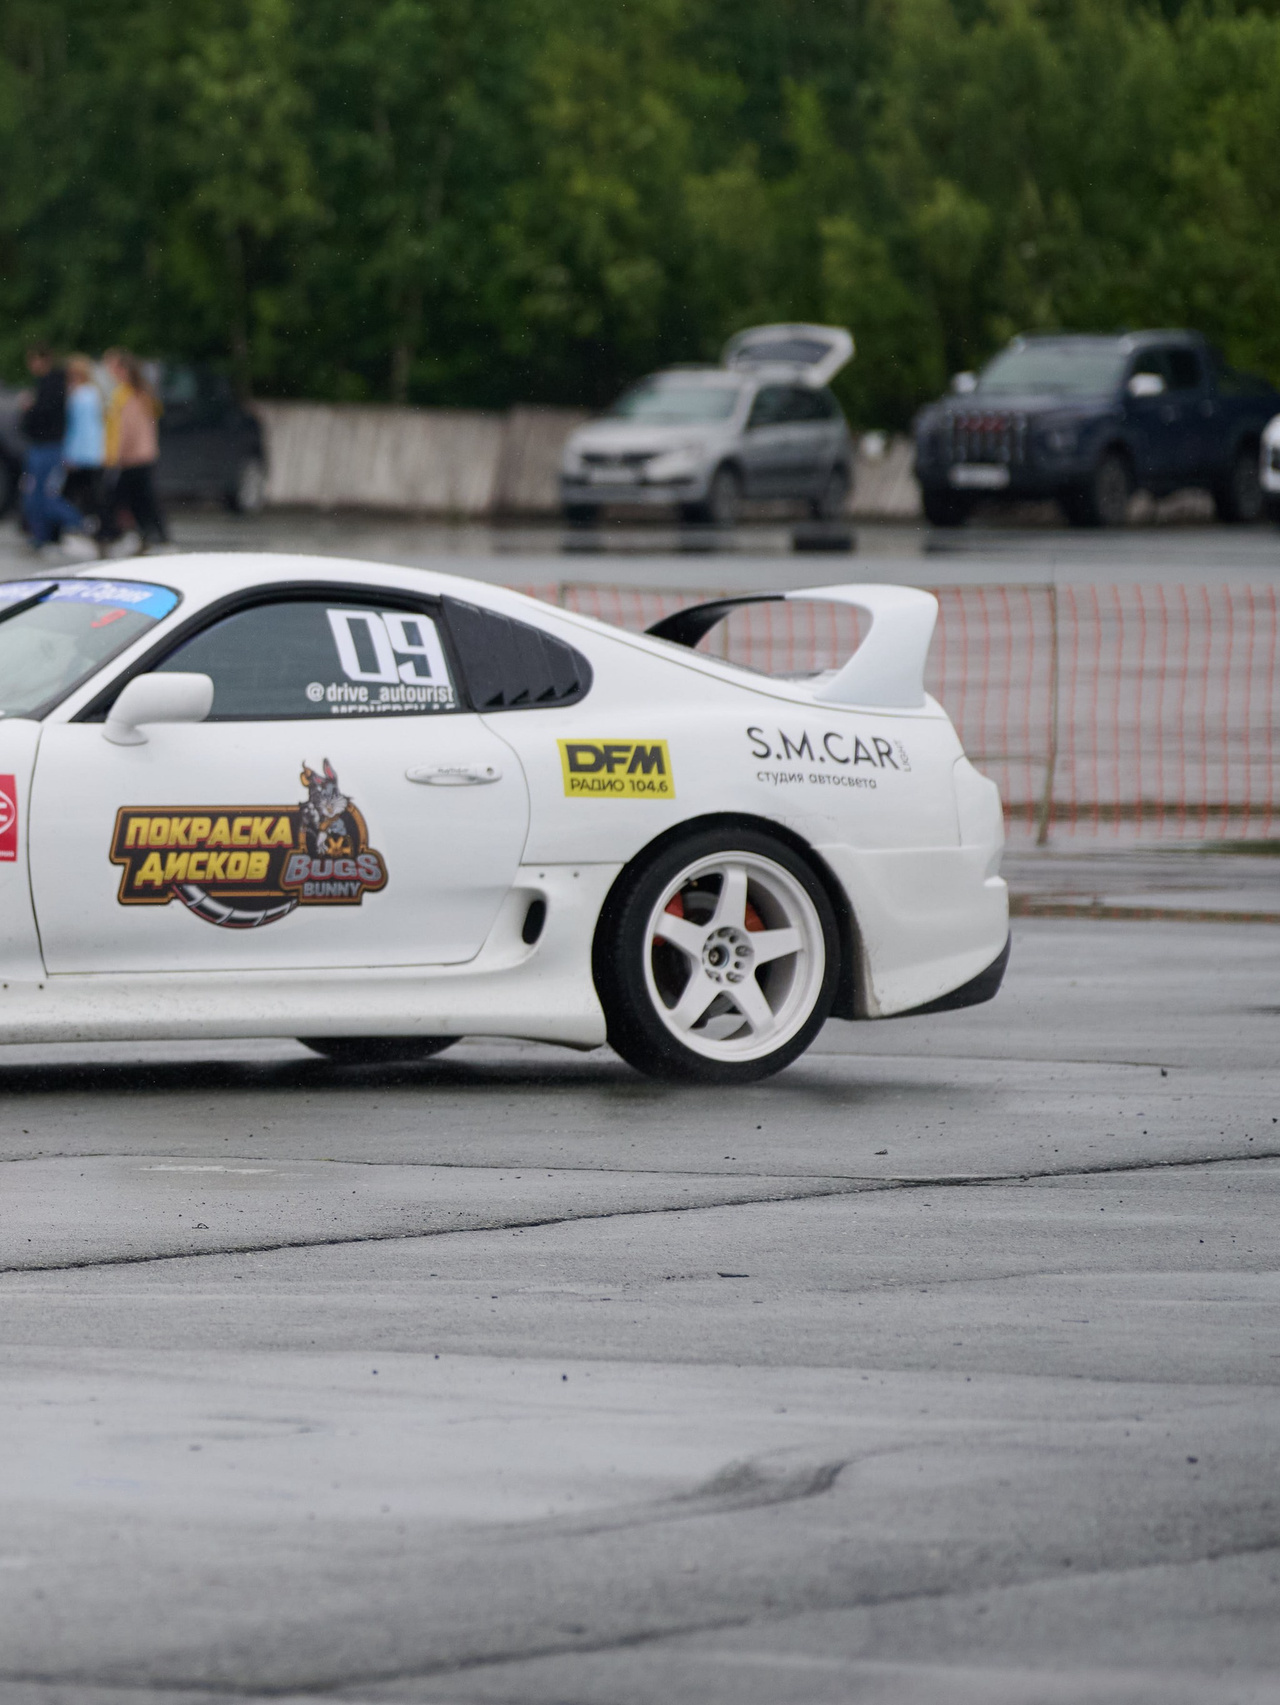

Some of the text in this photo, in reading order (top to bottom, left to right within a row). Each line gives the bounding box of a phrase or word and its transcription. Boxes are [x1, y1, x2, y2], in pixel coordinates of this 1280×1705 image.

[326, 608, 451, 687] 09
[305, 682, 455, 705] @drive_autourist
[565, 744, 666, 775] DFM
[746, 726, 900, 770] S.M.CAR
[570, 778, 625, 792] РАДИО
[756, 771, 877, 789] студия автосвета
[124, 815, 294, 848] ПОКРАСКА
[135, 851, 269, 887] ДИСКОВ
[284, 854, 382, 883] BUGS
[304, 882, 361, 897] BUNNY
